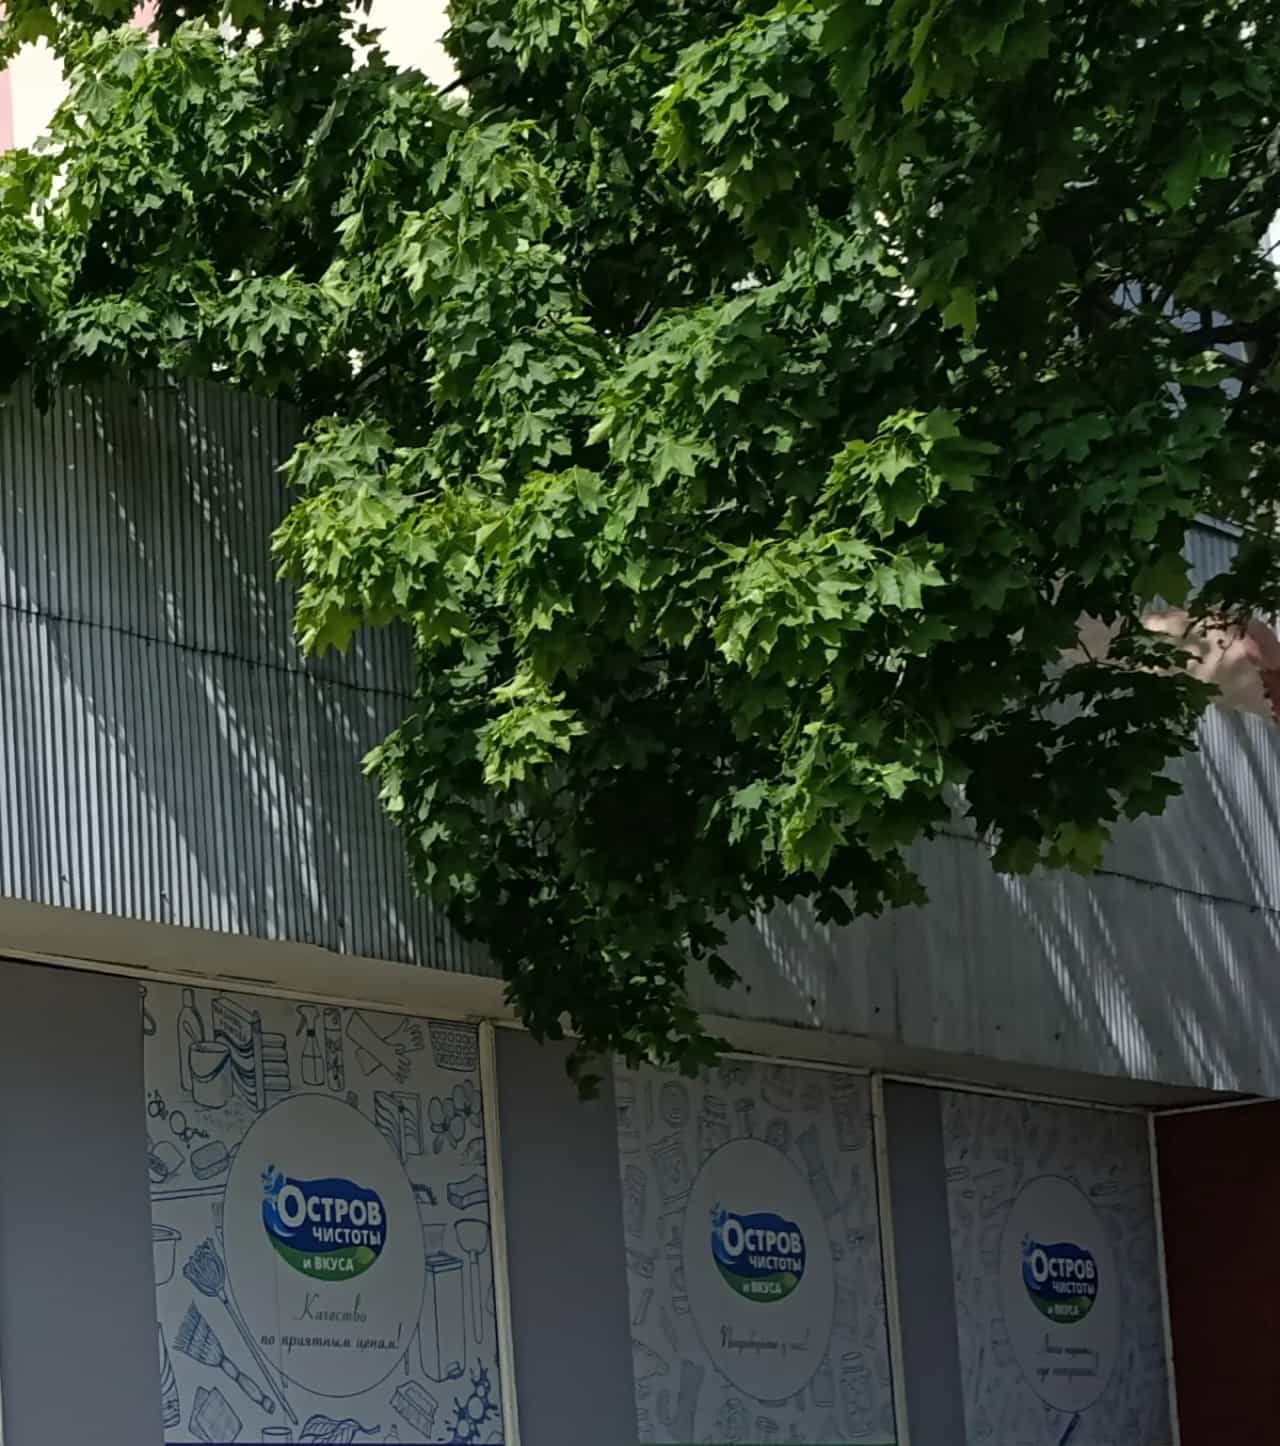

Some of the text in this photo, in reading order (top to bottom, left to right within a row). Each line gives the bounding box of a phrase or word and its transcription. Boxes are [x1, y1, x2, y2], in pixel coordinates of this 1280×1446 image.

[277, 1185, 382, 1227] ОСТРОВ
[313, 1227, 381, 1246] ЧИСТОТЫ
[722, 1219, 802, 1256] ОСТРОВ
[315, 1258, 354, 1272] ВКУСА
[749, 1256, 802, 1271] ЧИСТОТЫ
[1031, 1249, 1095, 1282] ОСТРОВ
[293, 1293, 368, 1323] Качество
